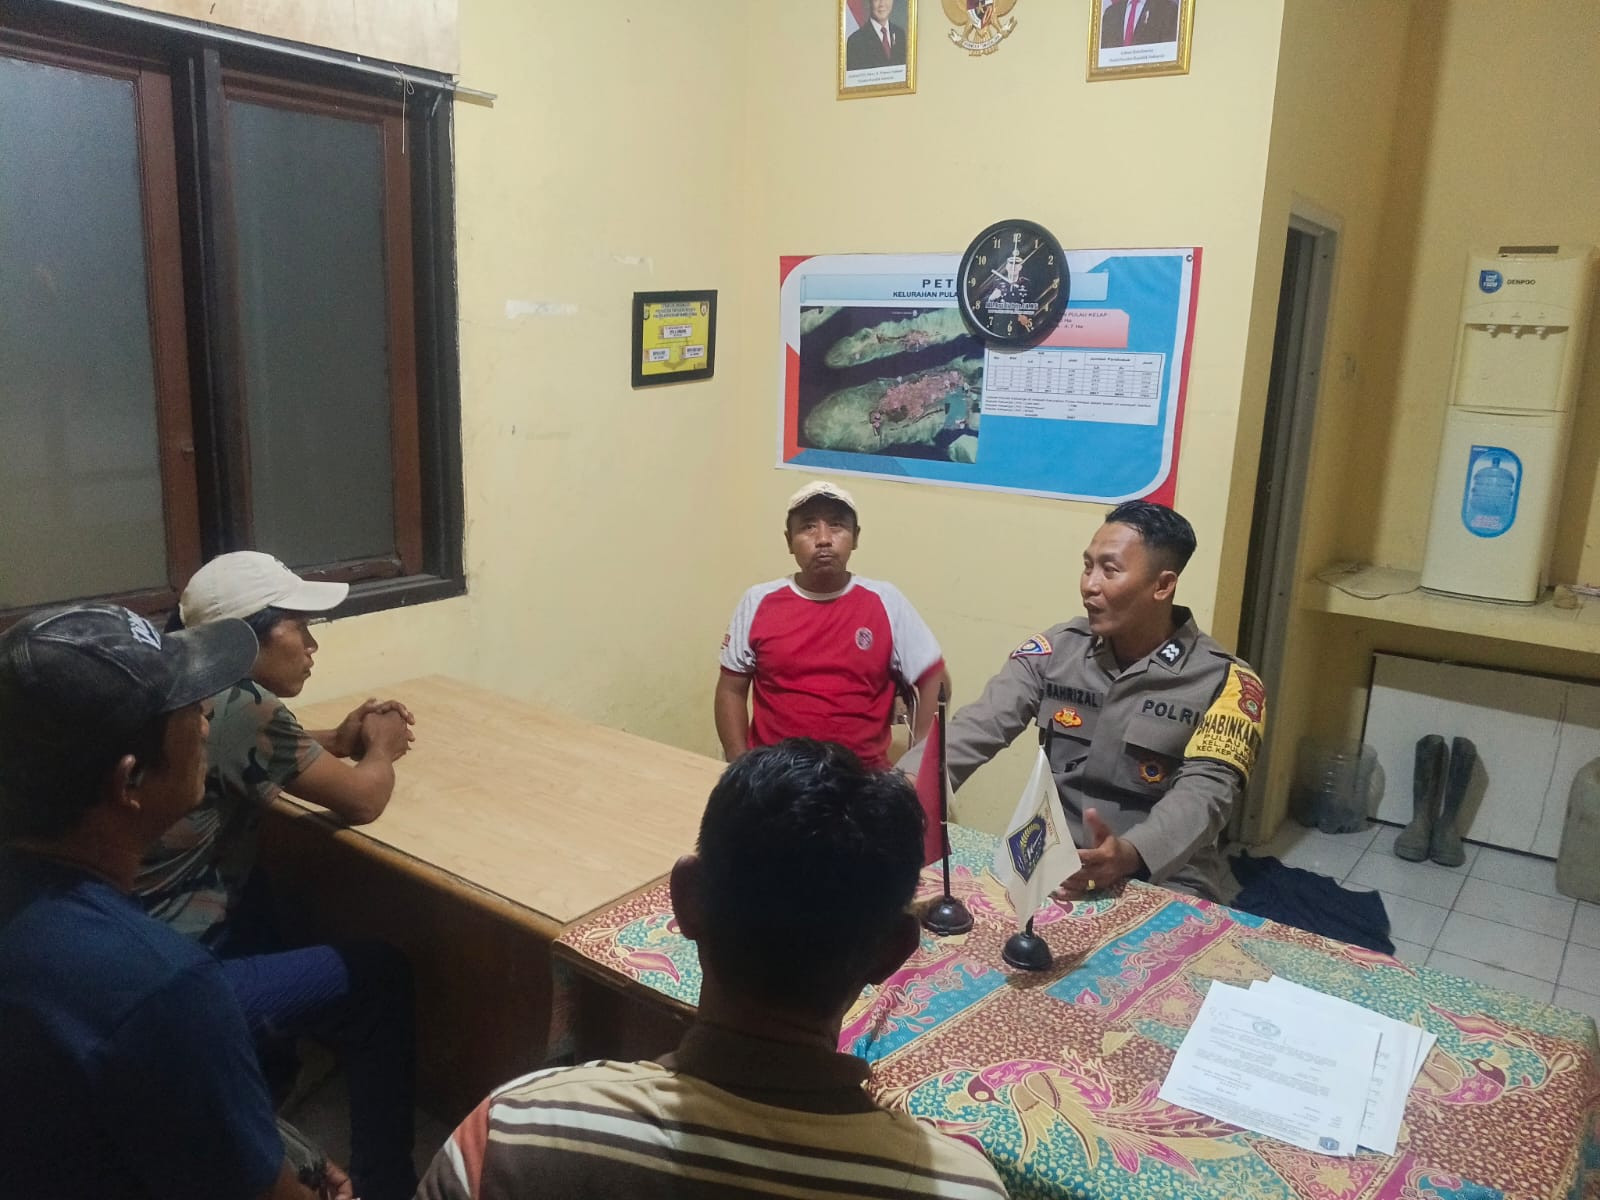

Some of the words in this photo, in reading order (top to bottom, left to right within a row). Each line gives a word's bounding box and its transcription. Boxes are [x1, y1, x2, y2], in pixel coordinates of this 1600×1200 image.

[993, 238, 1001, 248] 11
[978, 255, 987, 265] 10
[1047, 255, 1054, 265] 2
[970, 277, 977, 287] 9
[892, 290, 938, 298] KELURAHAN
[974, 300, 981, 310] 8
[988, 316, 994, 326] 7
[1007, 320, 1013, 332] 6
[1142, 699, 1200, 727] POLRI
[1203, 733, 1241, 748] PULAU
